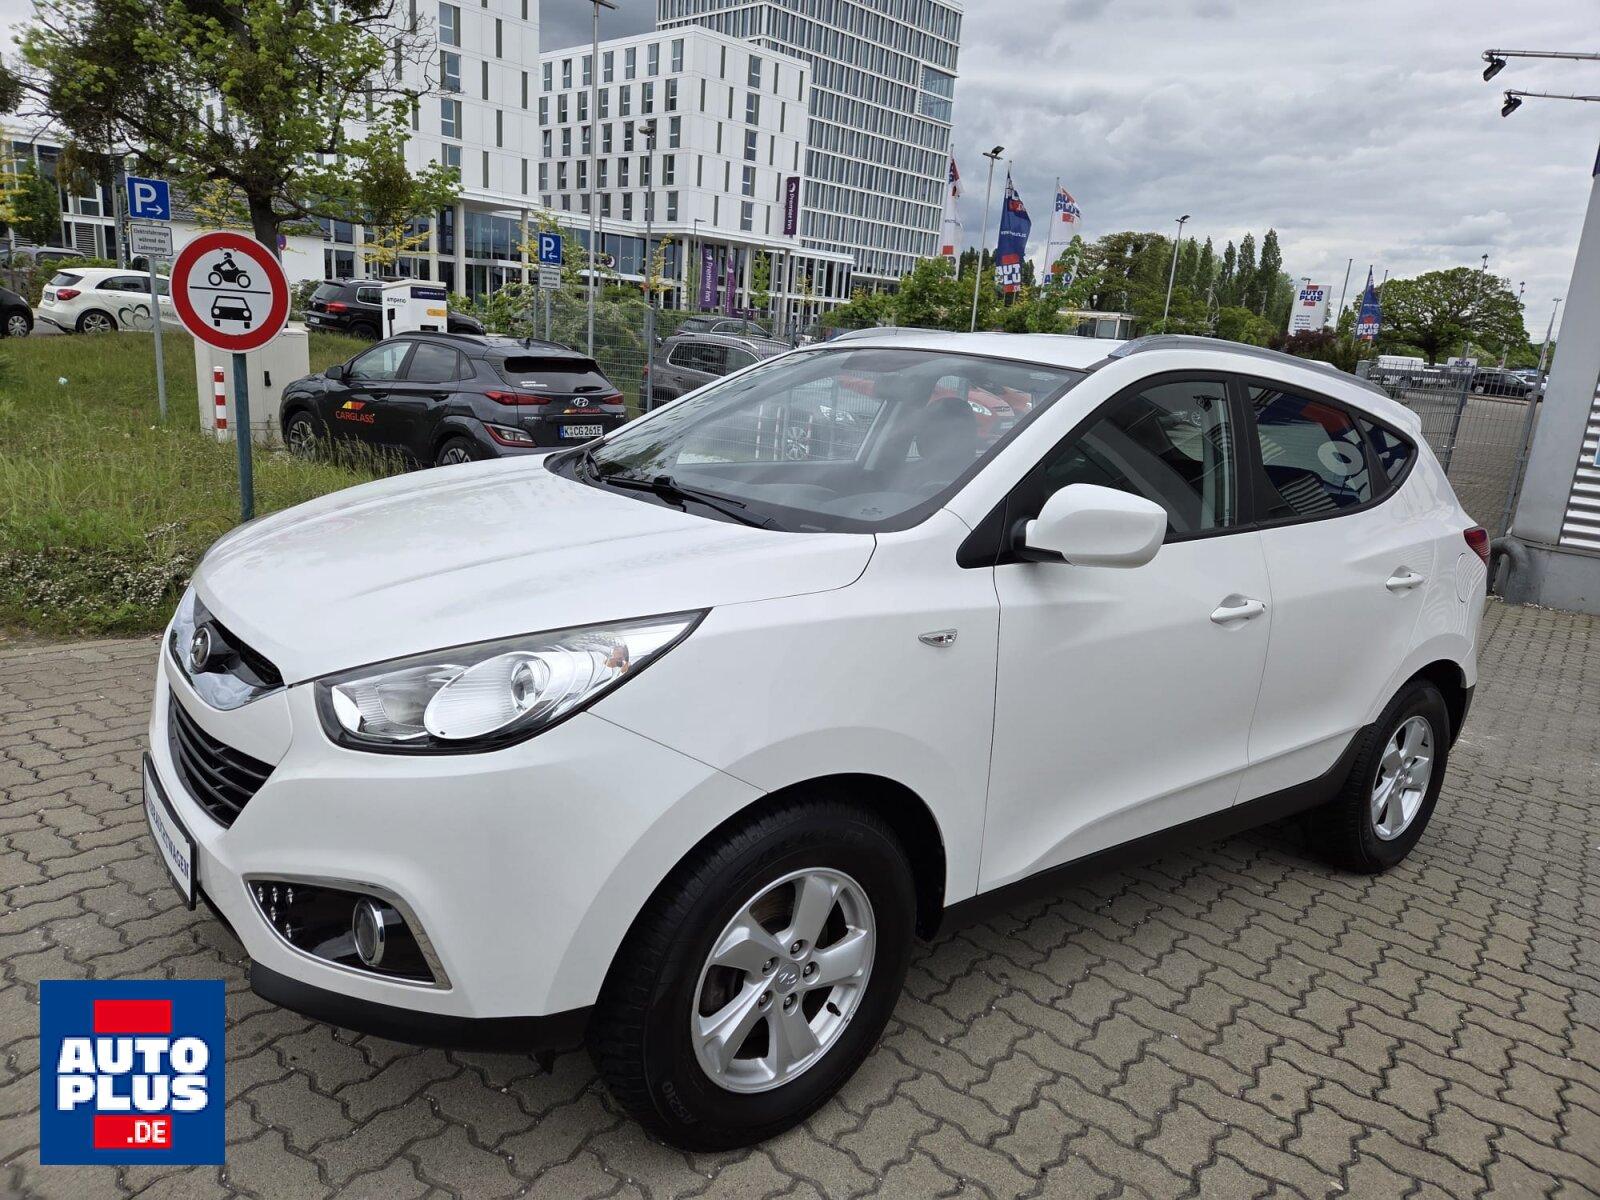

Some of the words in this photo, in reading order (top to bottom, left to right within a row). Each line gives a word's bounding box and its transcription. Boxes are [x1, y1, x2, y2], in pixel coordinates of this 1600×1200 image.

[134, 183, 157, 213] P
[787, 193, 795, 219] Premier
[542, 236, 555, 259] P
[995, 263, 1021, 276] AUT
[994, 273, 1021, 285] PLU
[335, 410, 375, 424] CARGLASS
